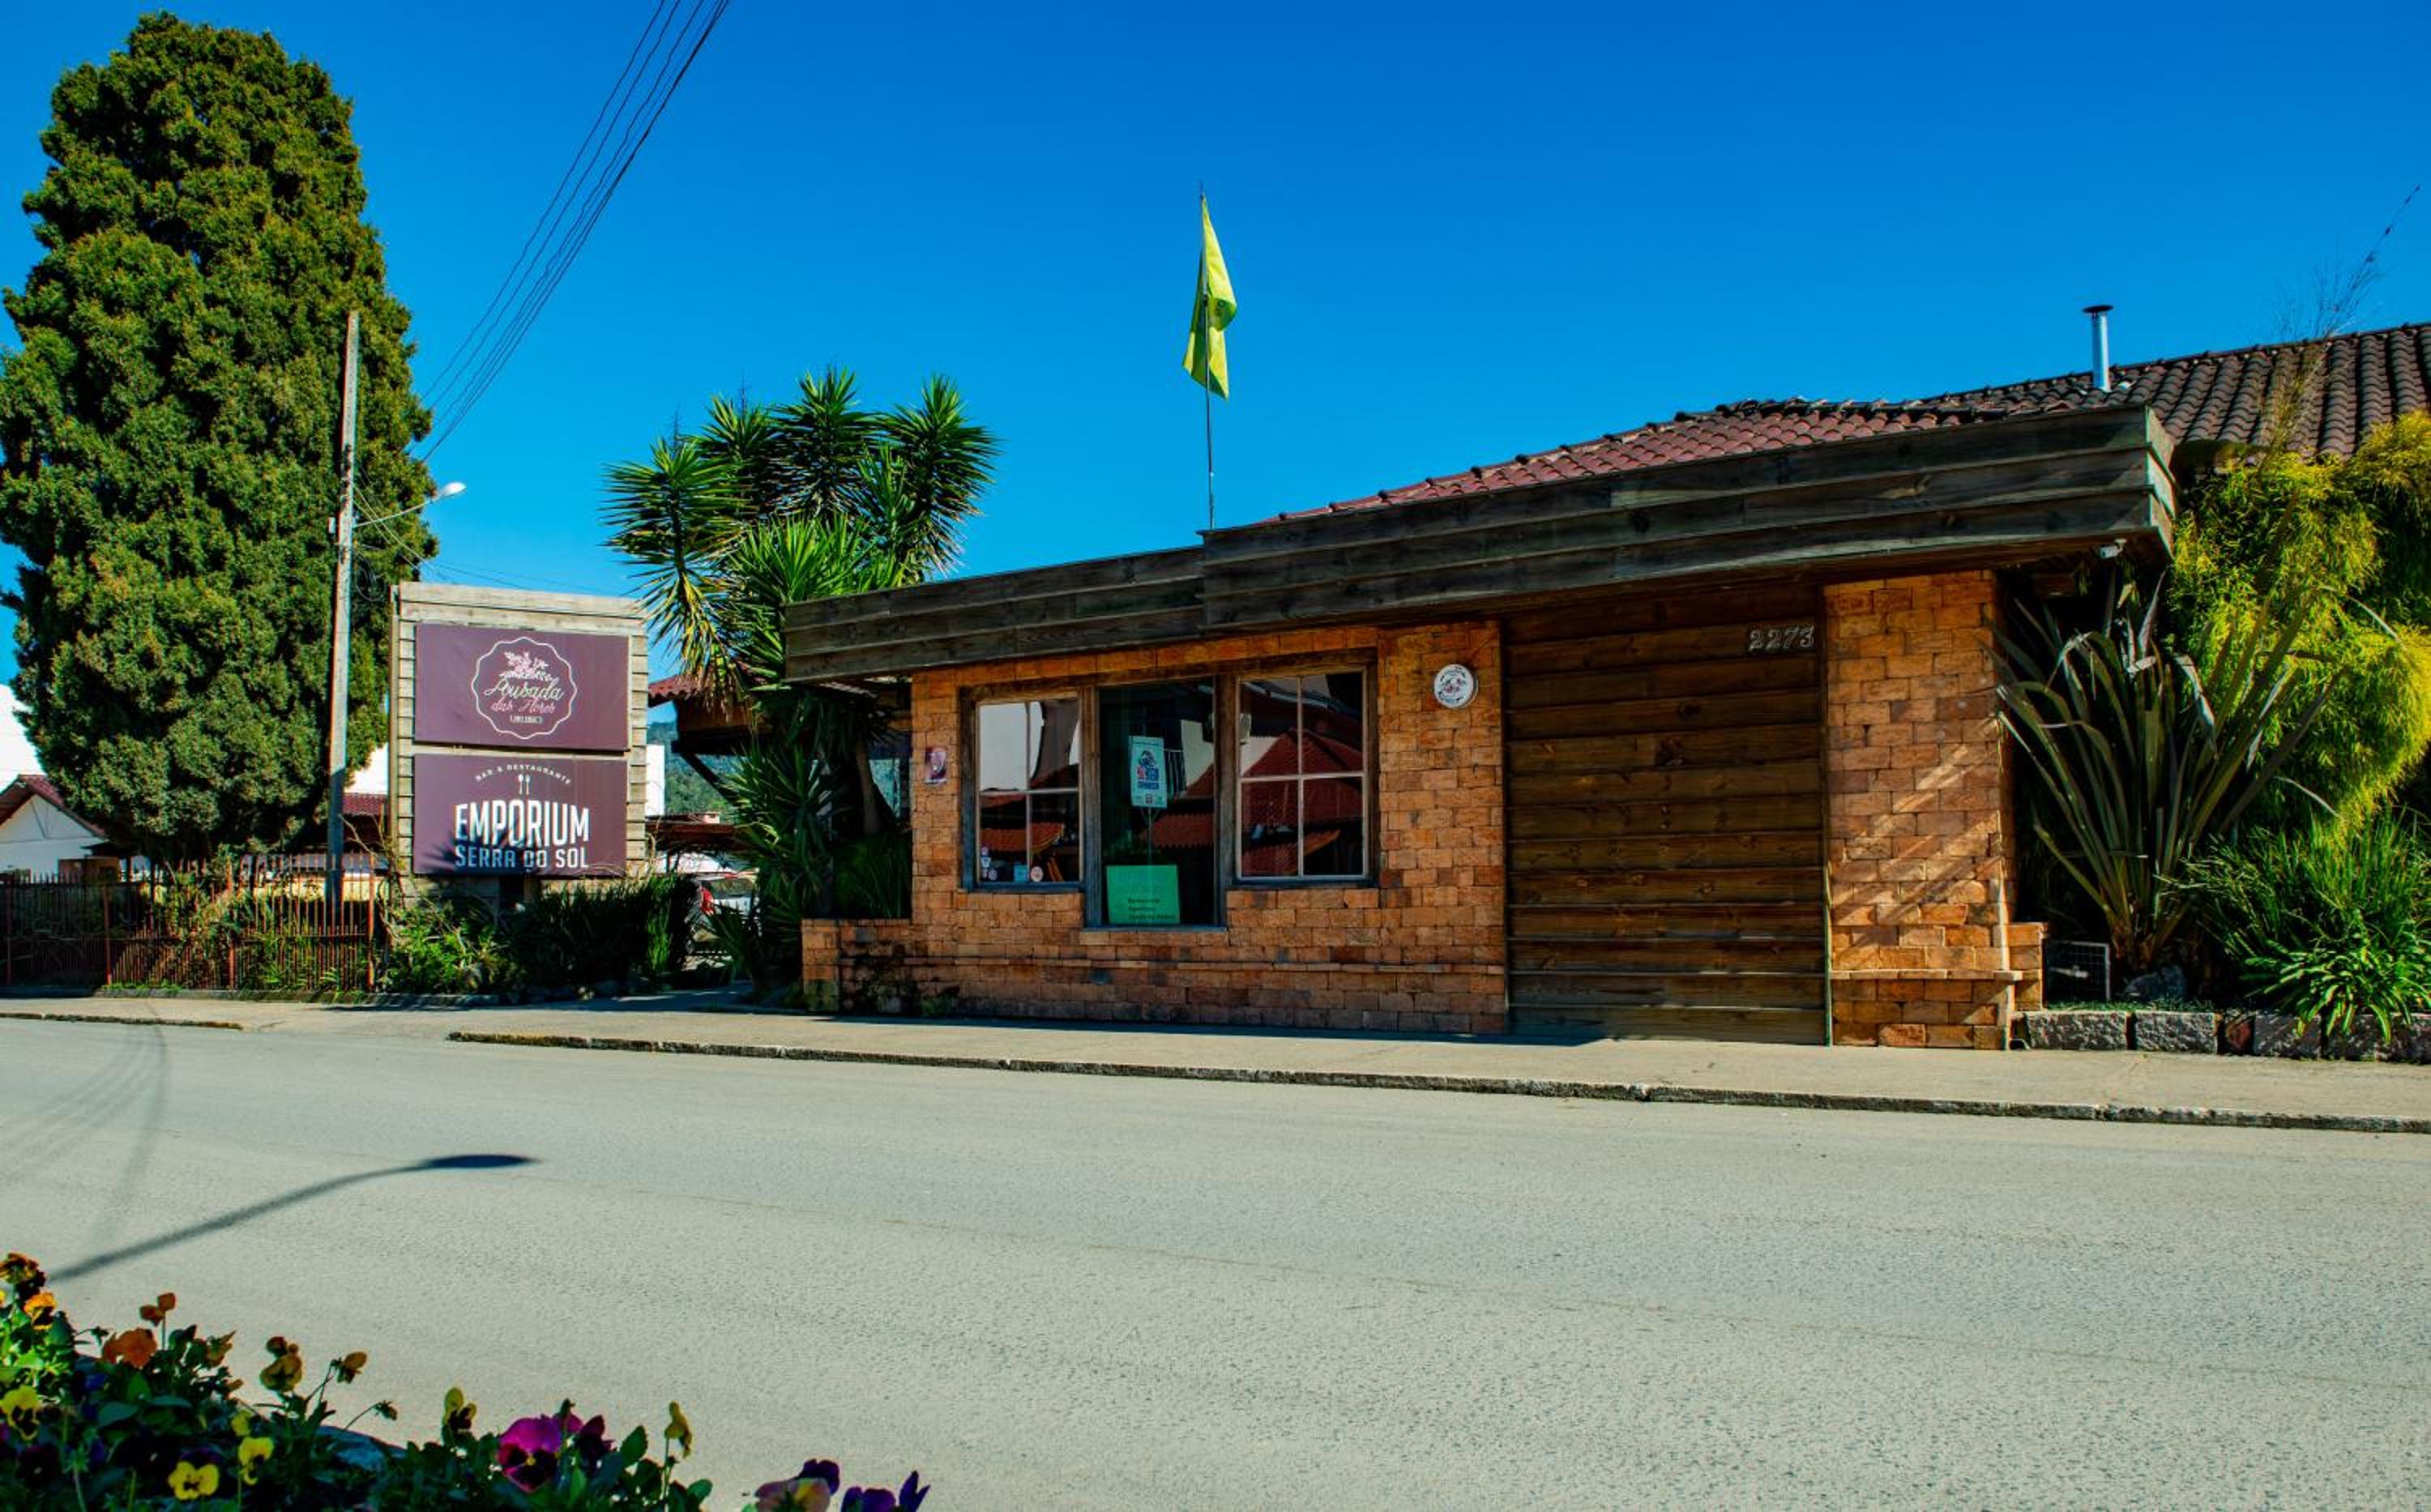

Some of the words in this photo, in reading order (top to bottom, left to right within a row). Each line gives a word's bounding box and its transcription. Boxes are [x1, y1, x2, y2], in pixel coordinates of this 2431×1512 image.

[1748, 625, 1815, 651] 2273
[484, 676, 565, 701] Pousada
[506, 764, 572, 784] RESTAURANTE
[455, 799, 591, 848] EMPORIUM
[455, 844, 516, 869] SERRA
[523, 846, 548, 869] DO
[555, 847, 590, 869] SOL
